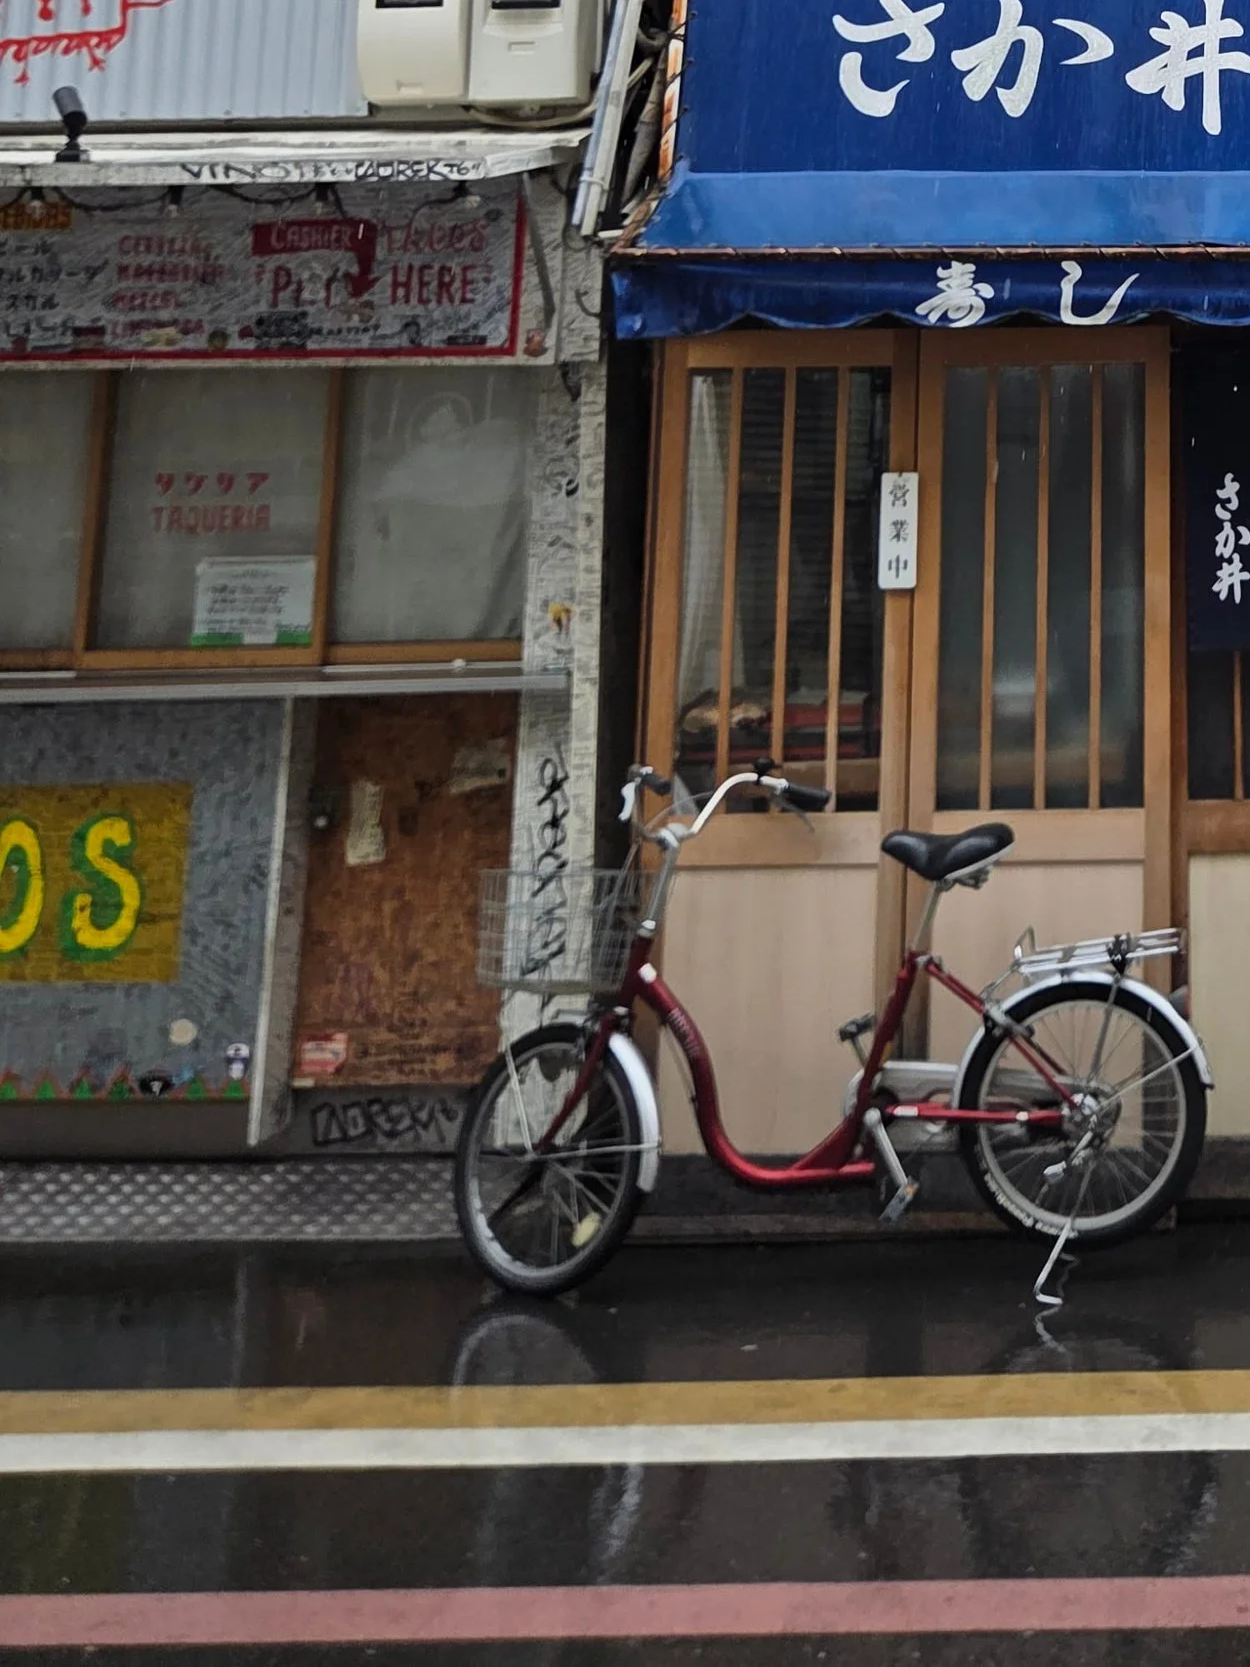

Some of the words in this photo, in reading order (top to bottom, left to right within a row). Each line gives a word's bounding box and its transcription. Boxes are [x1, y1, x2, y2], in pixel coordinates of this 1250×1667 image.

[270, 219, 353, 249] CASHIER
[389, 264, 475, 305] HERE
[916, 260, 1140, 327] 寿し
[151, 503, 271, 535] TAQUERIA
